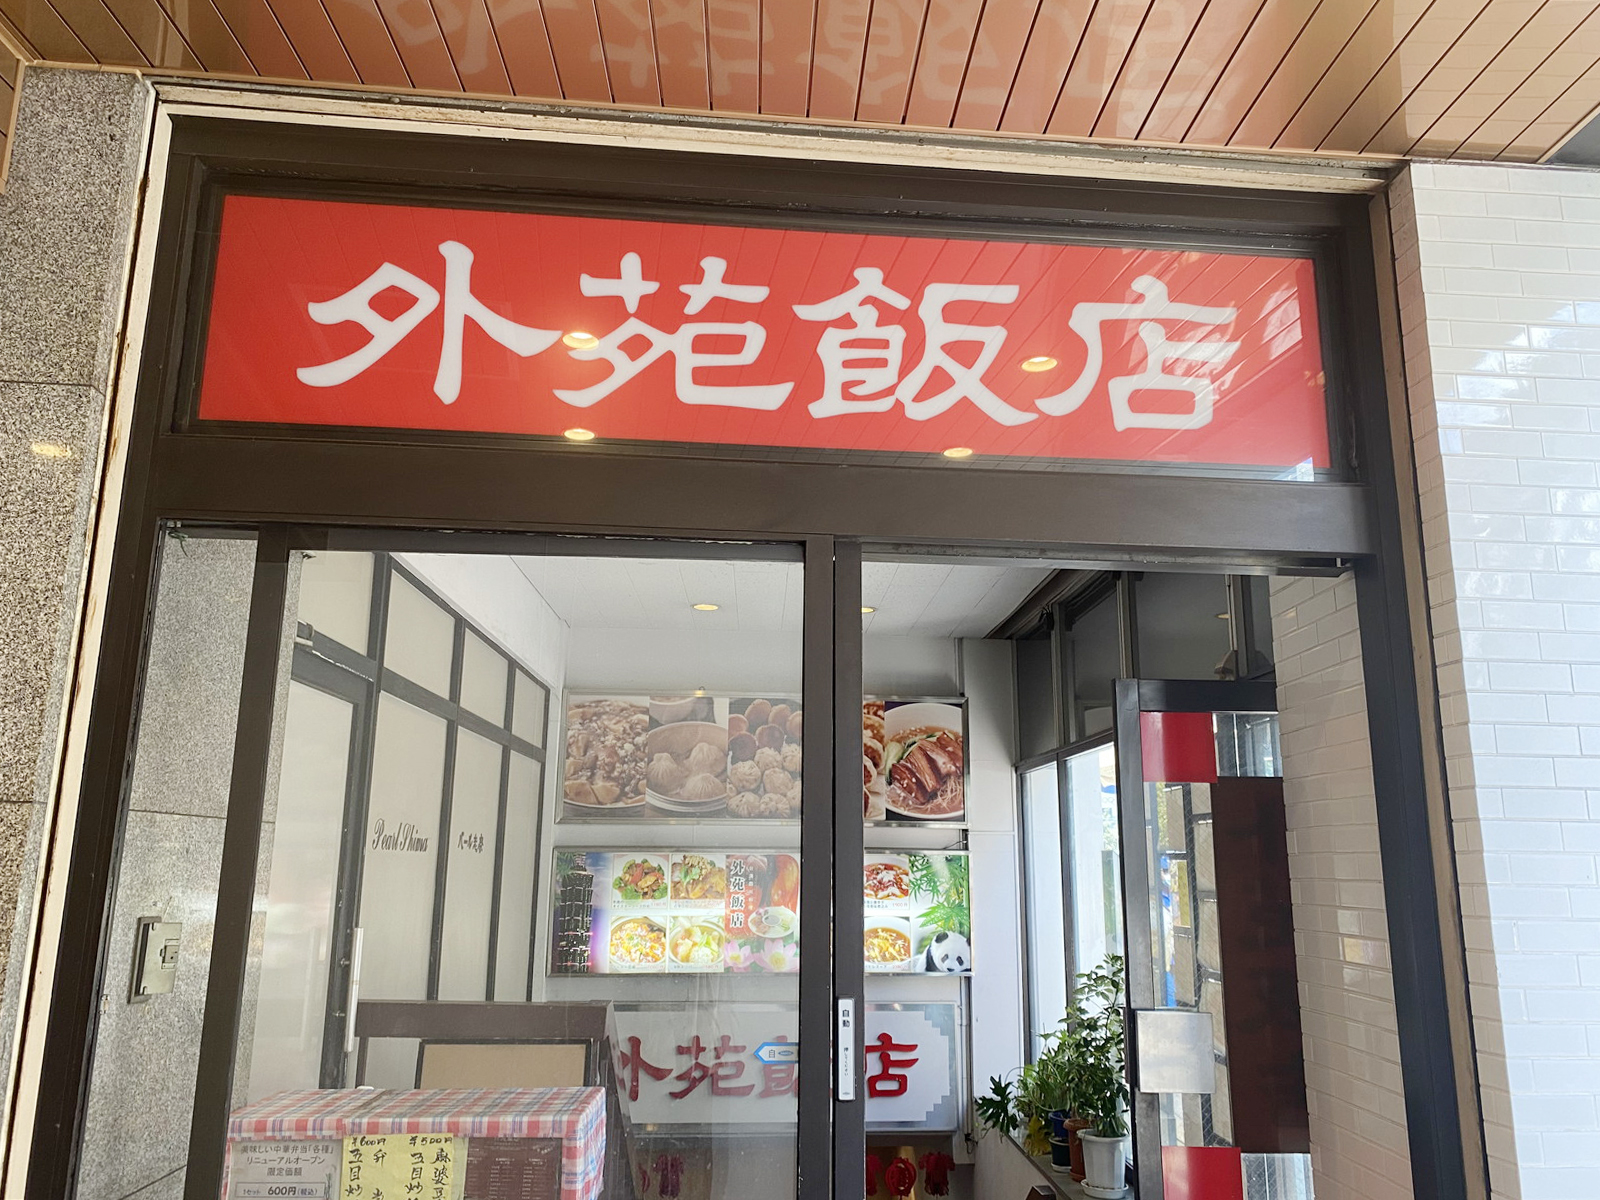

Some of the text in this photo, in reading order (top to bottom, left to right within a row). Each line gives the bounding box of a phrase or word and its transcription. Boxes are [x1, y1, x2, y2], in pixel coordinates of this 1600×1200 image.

[296, 240, 1241, 433] 外苑飯店
[372, 818, 403, 851] Pearl
[730, 859, 745, 928] 外苑飯店
[842, 1009, 850, 1028] 自動
[619, 1033, 919, 1102] 苑店
[247, 1155, 325, 1165] リニューアルオープン
[404, 1152, 424, 1200] 五目炒
